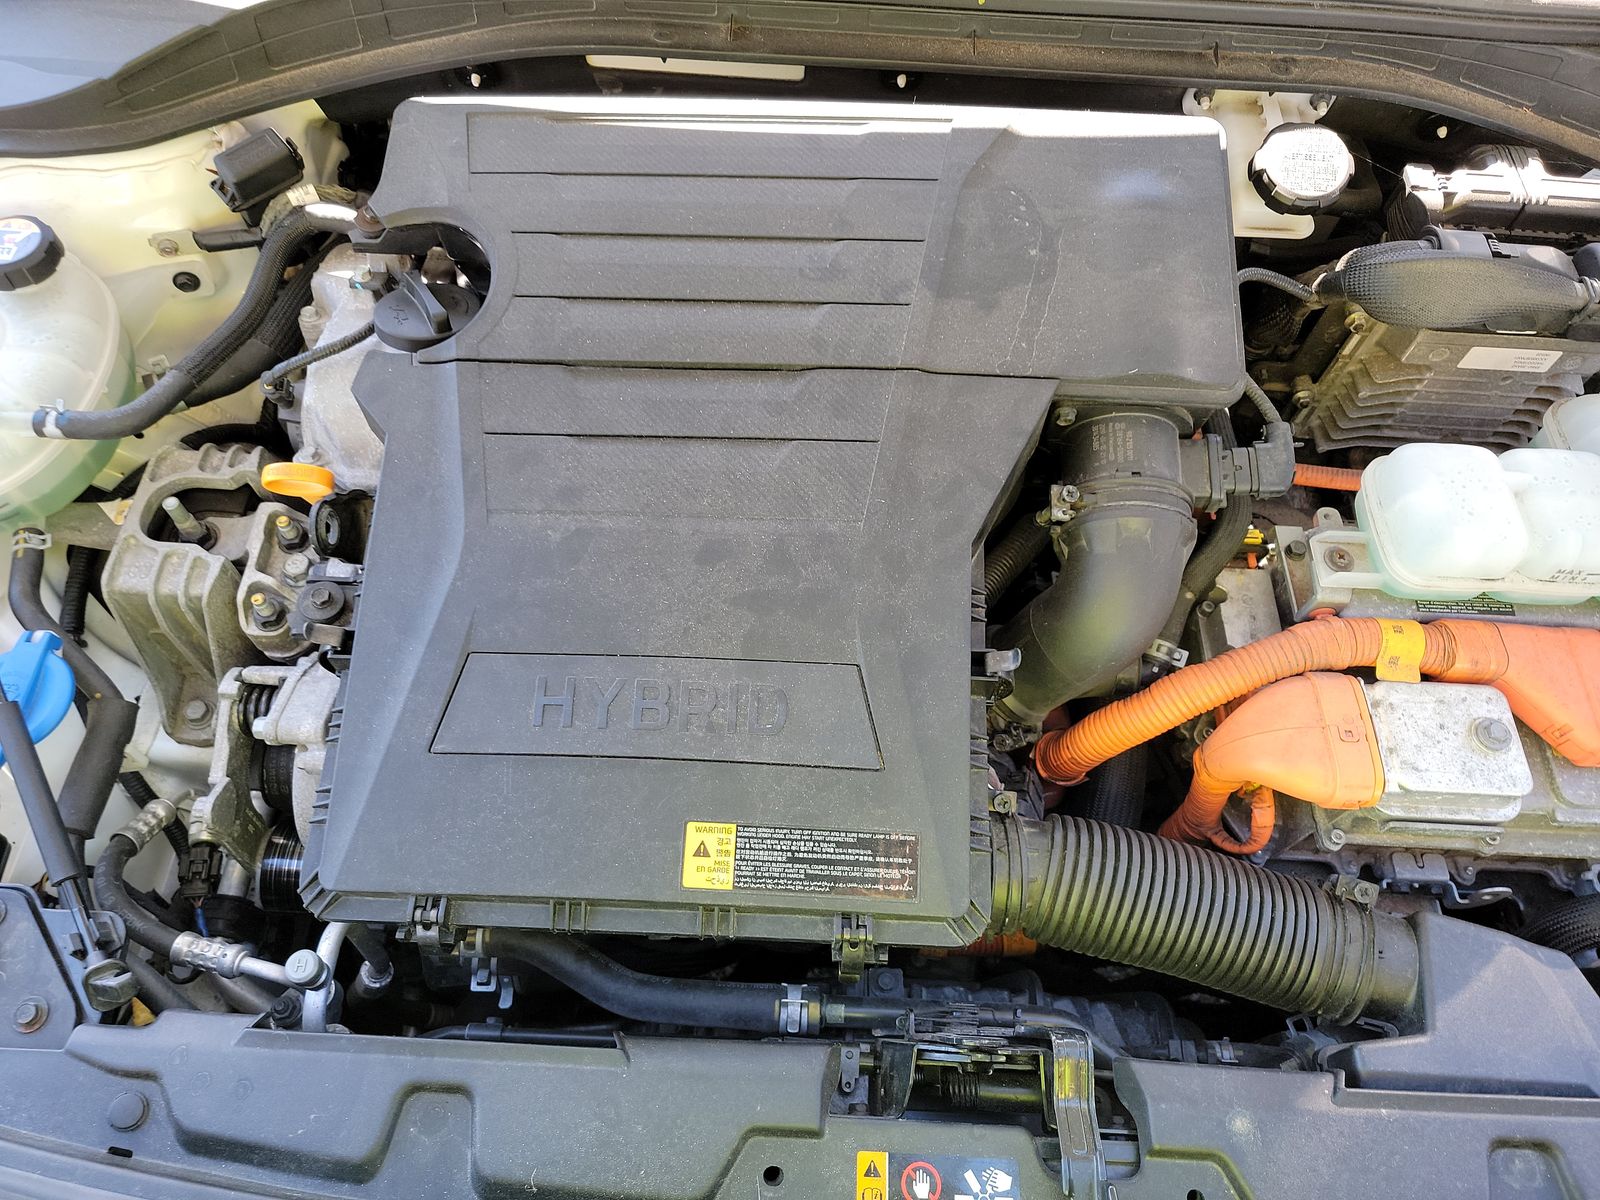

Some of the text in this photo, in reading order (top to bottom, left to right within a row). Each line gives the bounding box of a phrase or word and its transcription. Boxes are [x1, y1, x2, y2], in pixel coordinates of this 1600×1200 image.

[533, 675, 789, 735] HYBRID
[695, 826, 733, 835] WARNING
[294, 958, 308, 973] H
